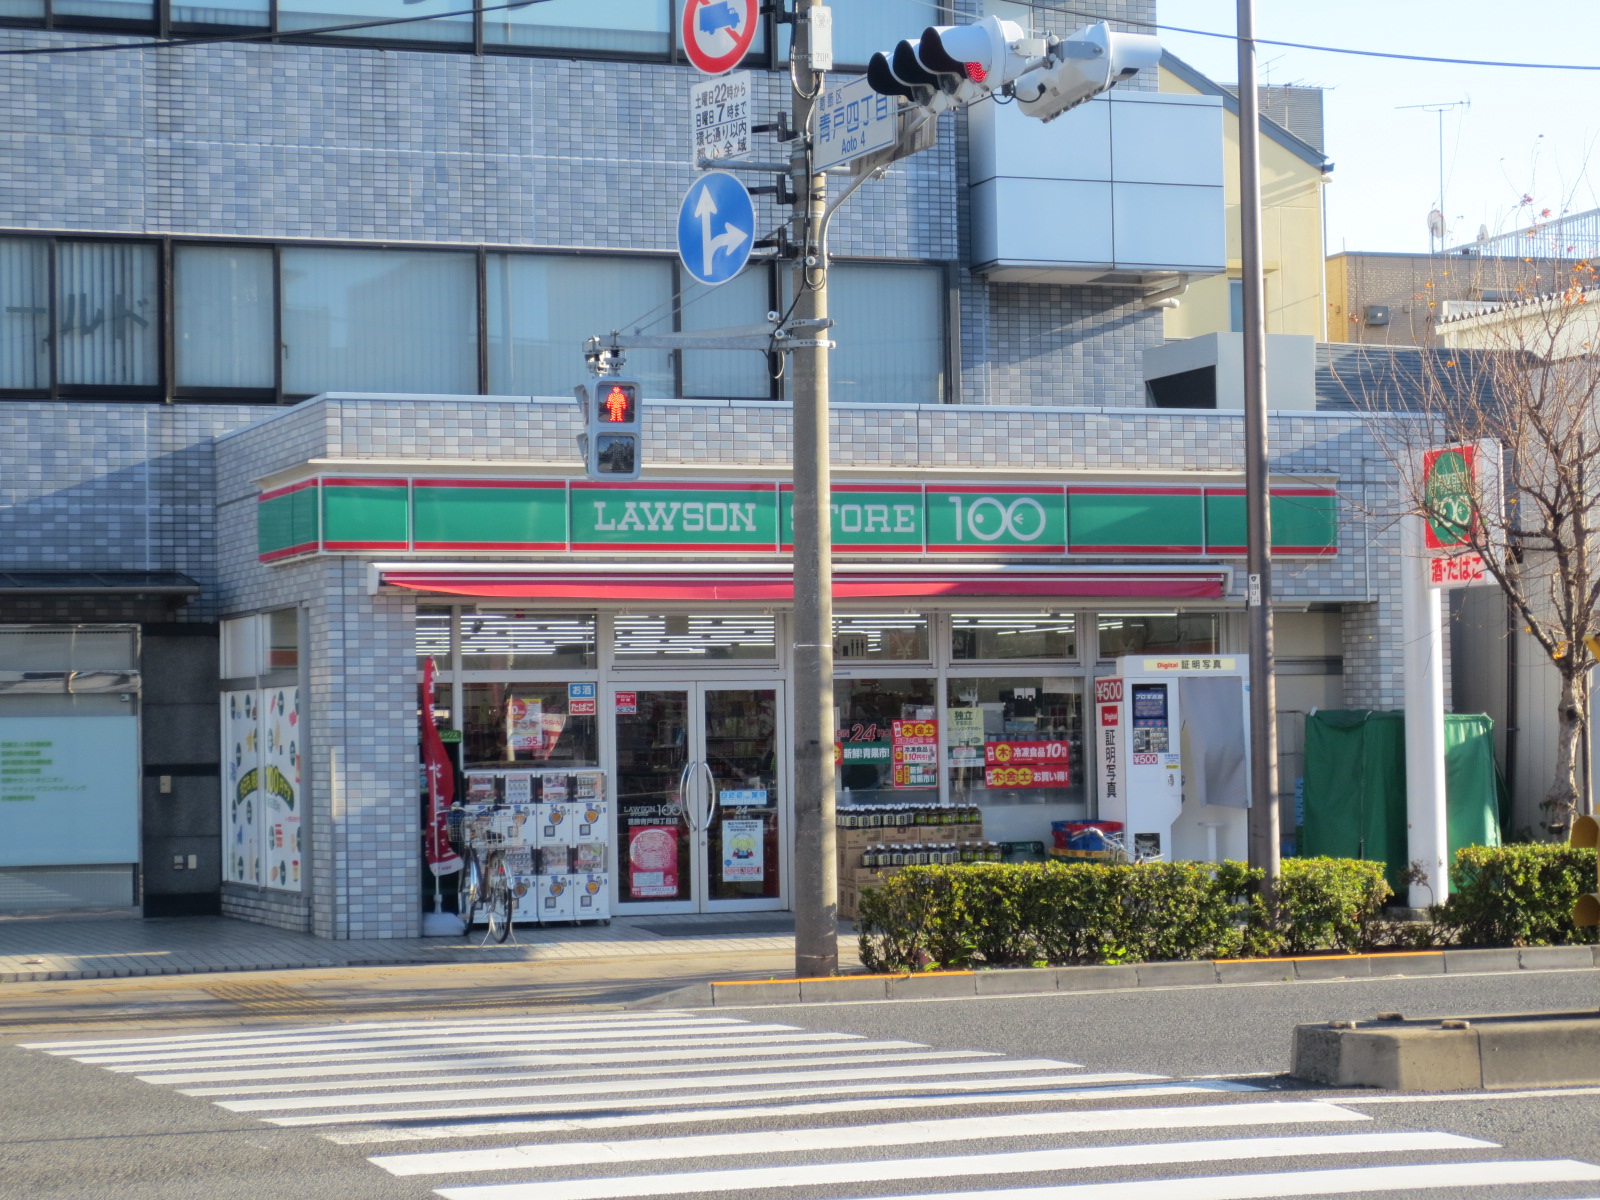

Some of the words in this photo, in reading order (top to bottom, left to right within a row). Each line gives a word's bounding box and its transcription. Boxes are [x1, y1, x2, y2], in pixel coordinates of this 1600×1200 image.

[695, 82, 746, 109] 土曜日22時から
[696, 101, 747, 128] 日曜日7時まで
[819, 92, 888, 144] 青戸四丁目
[696, 120, 747, 146] 環七通り以内
[841, 136, 858, 155] Aoto
[861, 131, 866, 146] 4
[594, 501, 757, 532] LAWSON
[949, 496, 1047, 541] 100
[1431, 556, 1483, 582] 酒・たばこ
[1181, 660, 1222, 670] 証明写真
[572, 685, 592, 695] お酒
[1096, 682, 1122, 700] ¥500
[570, 702, 595, 712] たばこ
[850, 723, 877, 742] 24
[1105, 729, 1117, 798] 証明写真
[1134, 755, 1157, 764] ¥500
